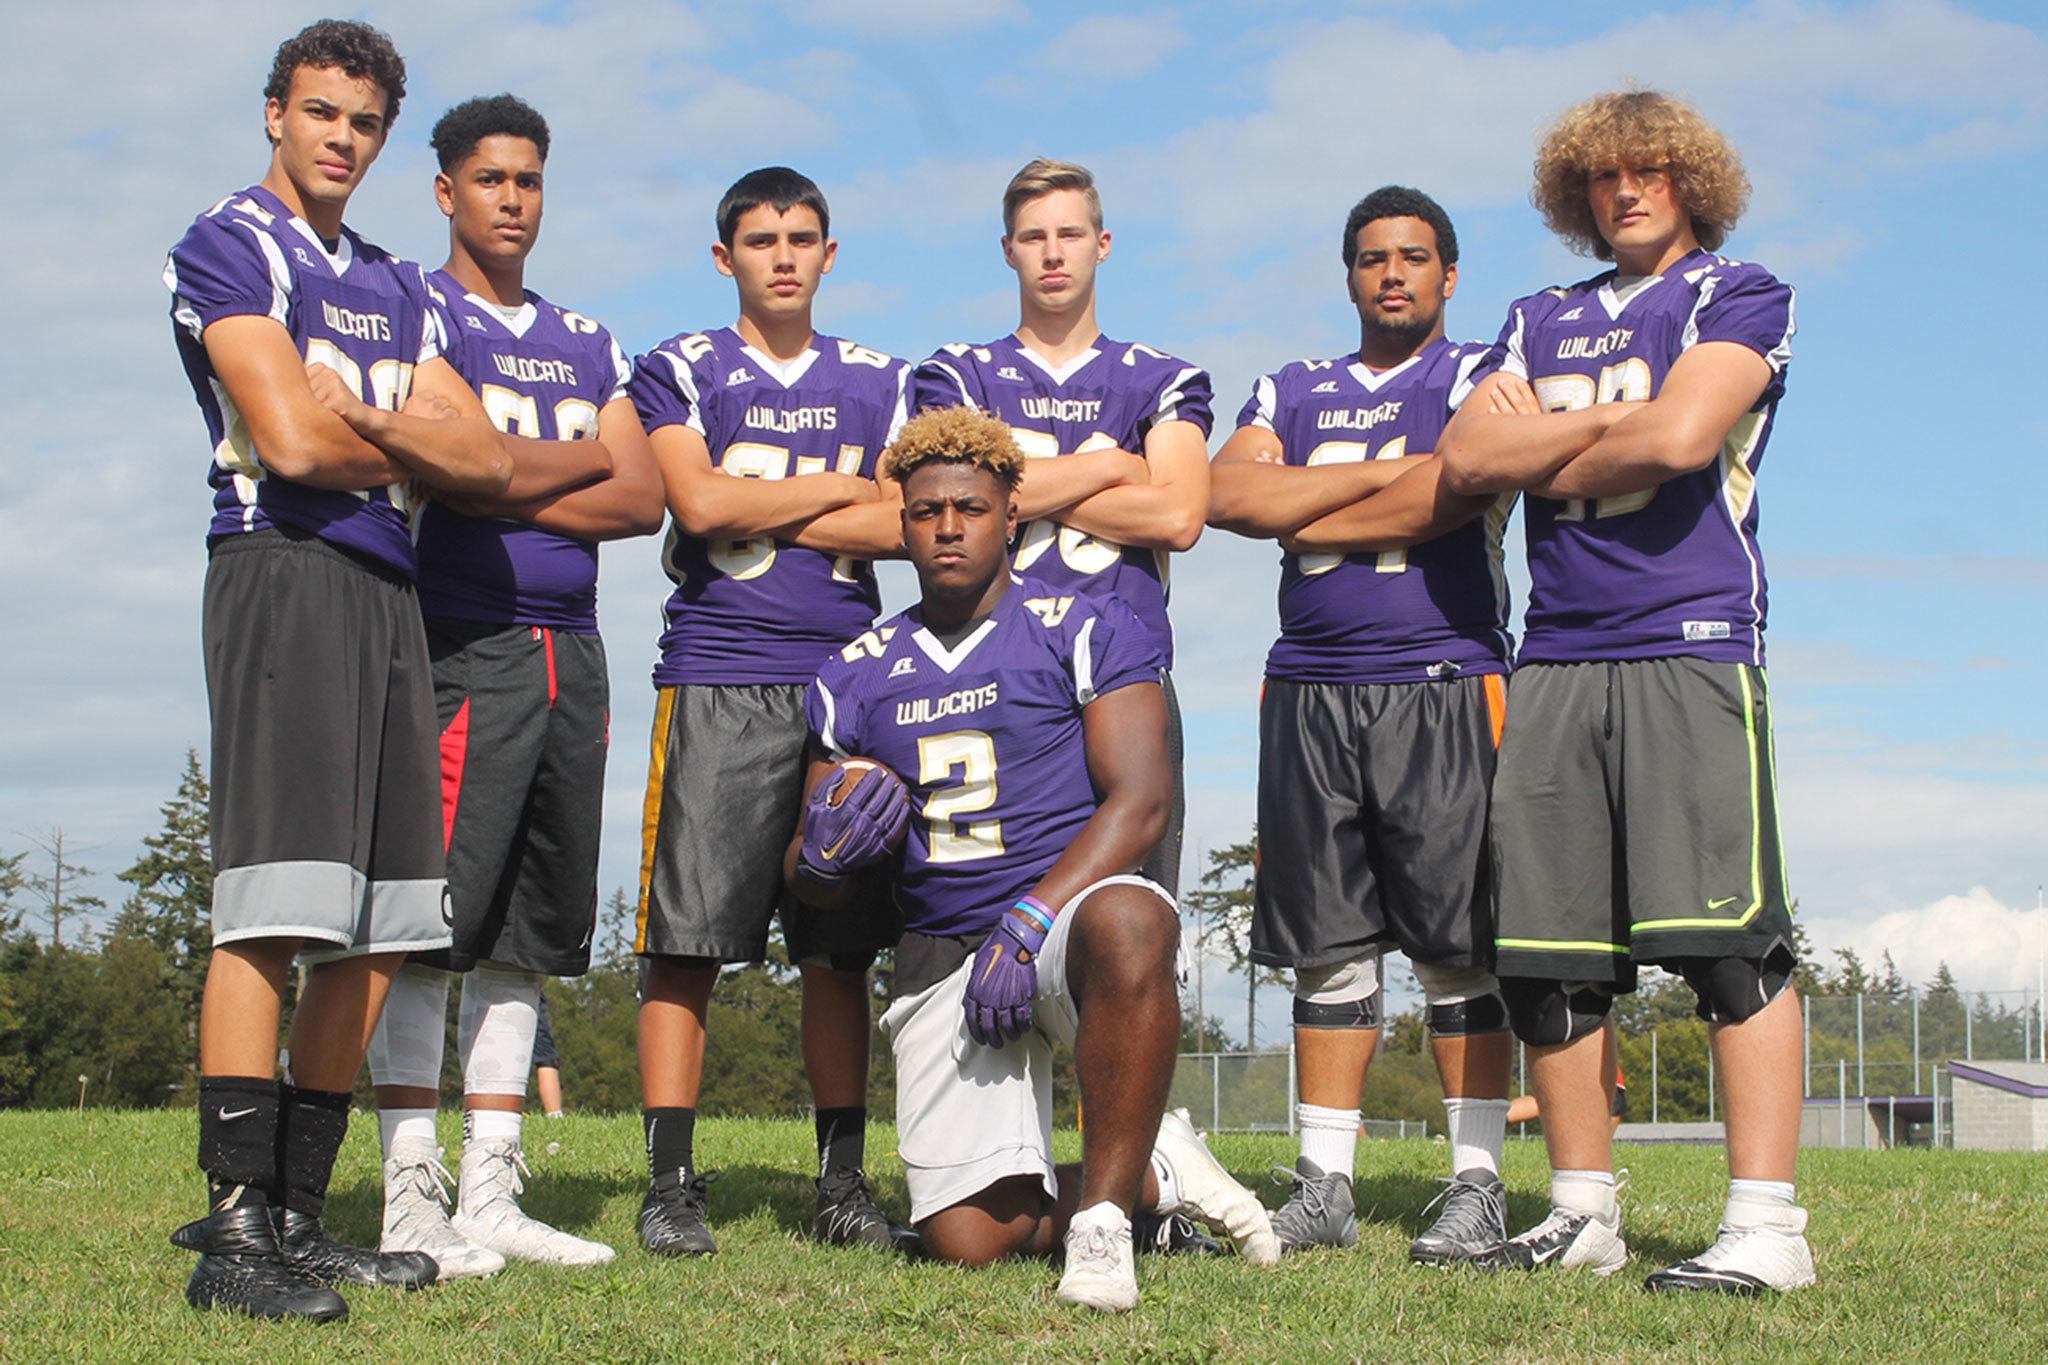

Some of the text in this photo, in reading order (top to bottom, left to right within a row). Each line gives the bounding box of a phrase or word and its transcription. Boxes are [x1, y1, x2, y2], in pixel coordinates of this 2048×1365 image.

[492, 352, 578, 387] WILDCATS
[895, 682, 998, 726] WILDCATS
[916, 729, 1006, 863] 2
